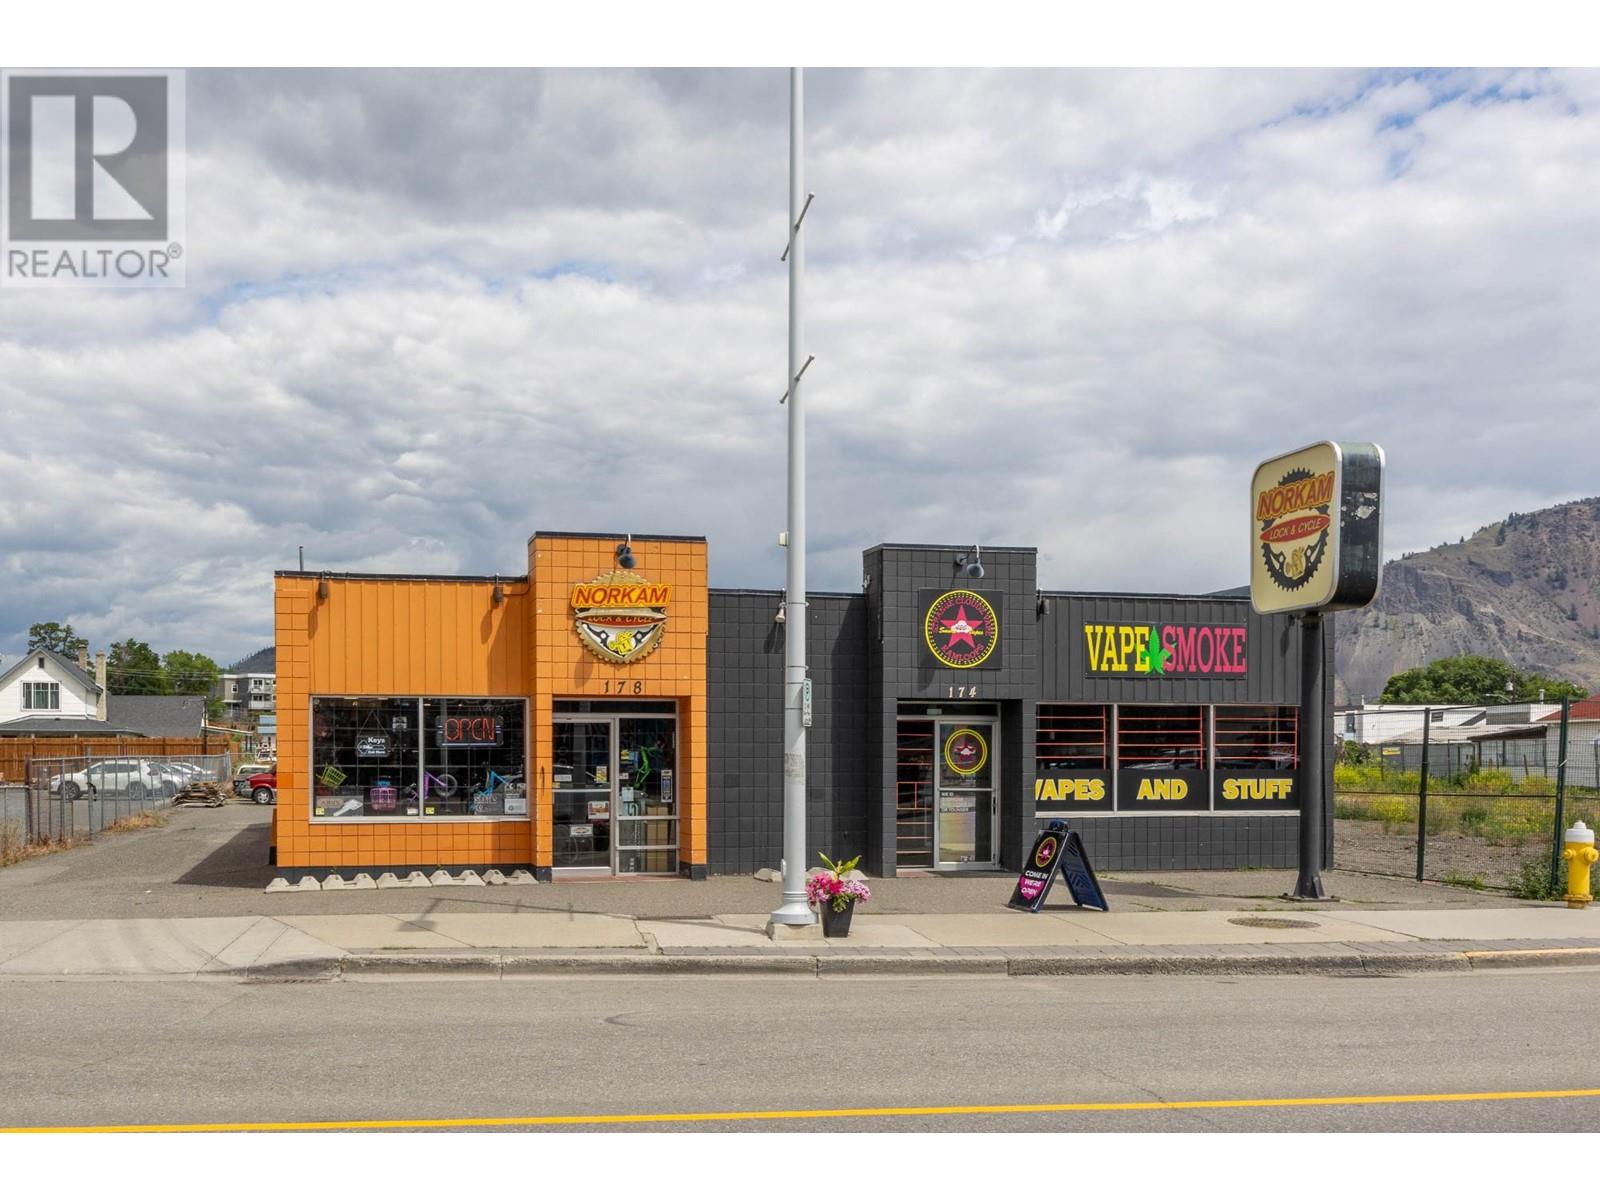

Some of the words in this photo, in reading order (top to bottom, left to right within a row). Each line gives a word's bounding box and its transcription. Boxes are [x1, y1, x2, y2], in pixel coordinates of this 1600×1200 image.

[1257, 473, 1334, 519] NORKAM
[1269, 526, 1290, 541] LOCK
[1290, 525, 1297, 536] &
[1297, 517, 1322, 534] CYCLE
[575, 587, 669, 605] NORKAM
[941, 642, 985, 661] KAMLOOPS
[1084, 625, 1150, 672] VAPE
[1162, 626, 1247, 673] SMOKE
[604, 680, 642, 694] 178
[948, 686, 977, 698] 174
[367, 736, 386, 744] Keys
[1136, 778, 1188, 800] AND
[1222, 778, 1293, 800] STUFF
[1025, 870, 1042, 878] COME
[1021, 887, 1039, 896] OPEN
